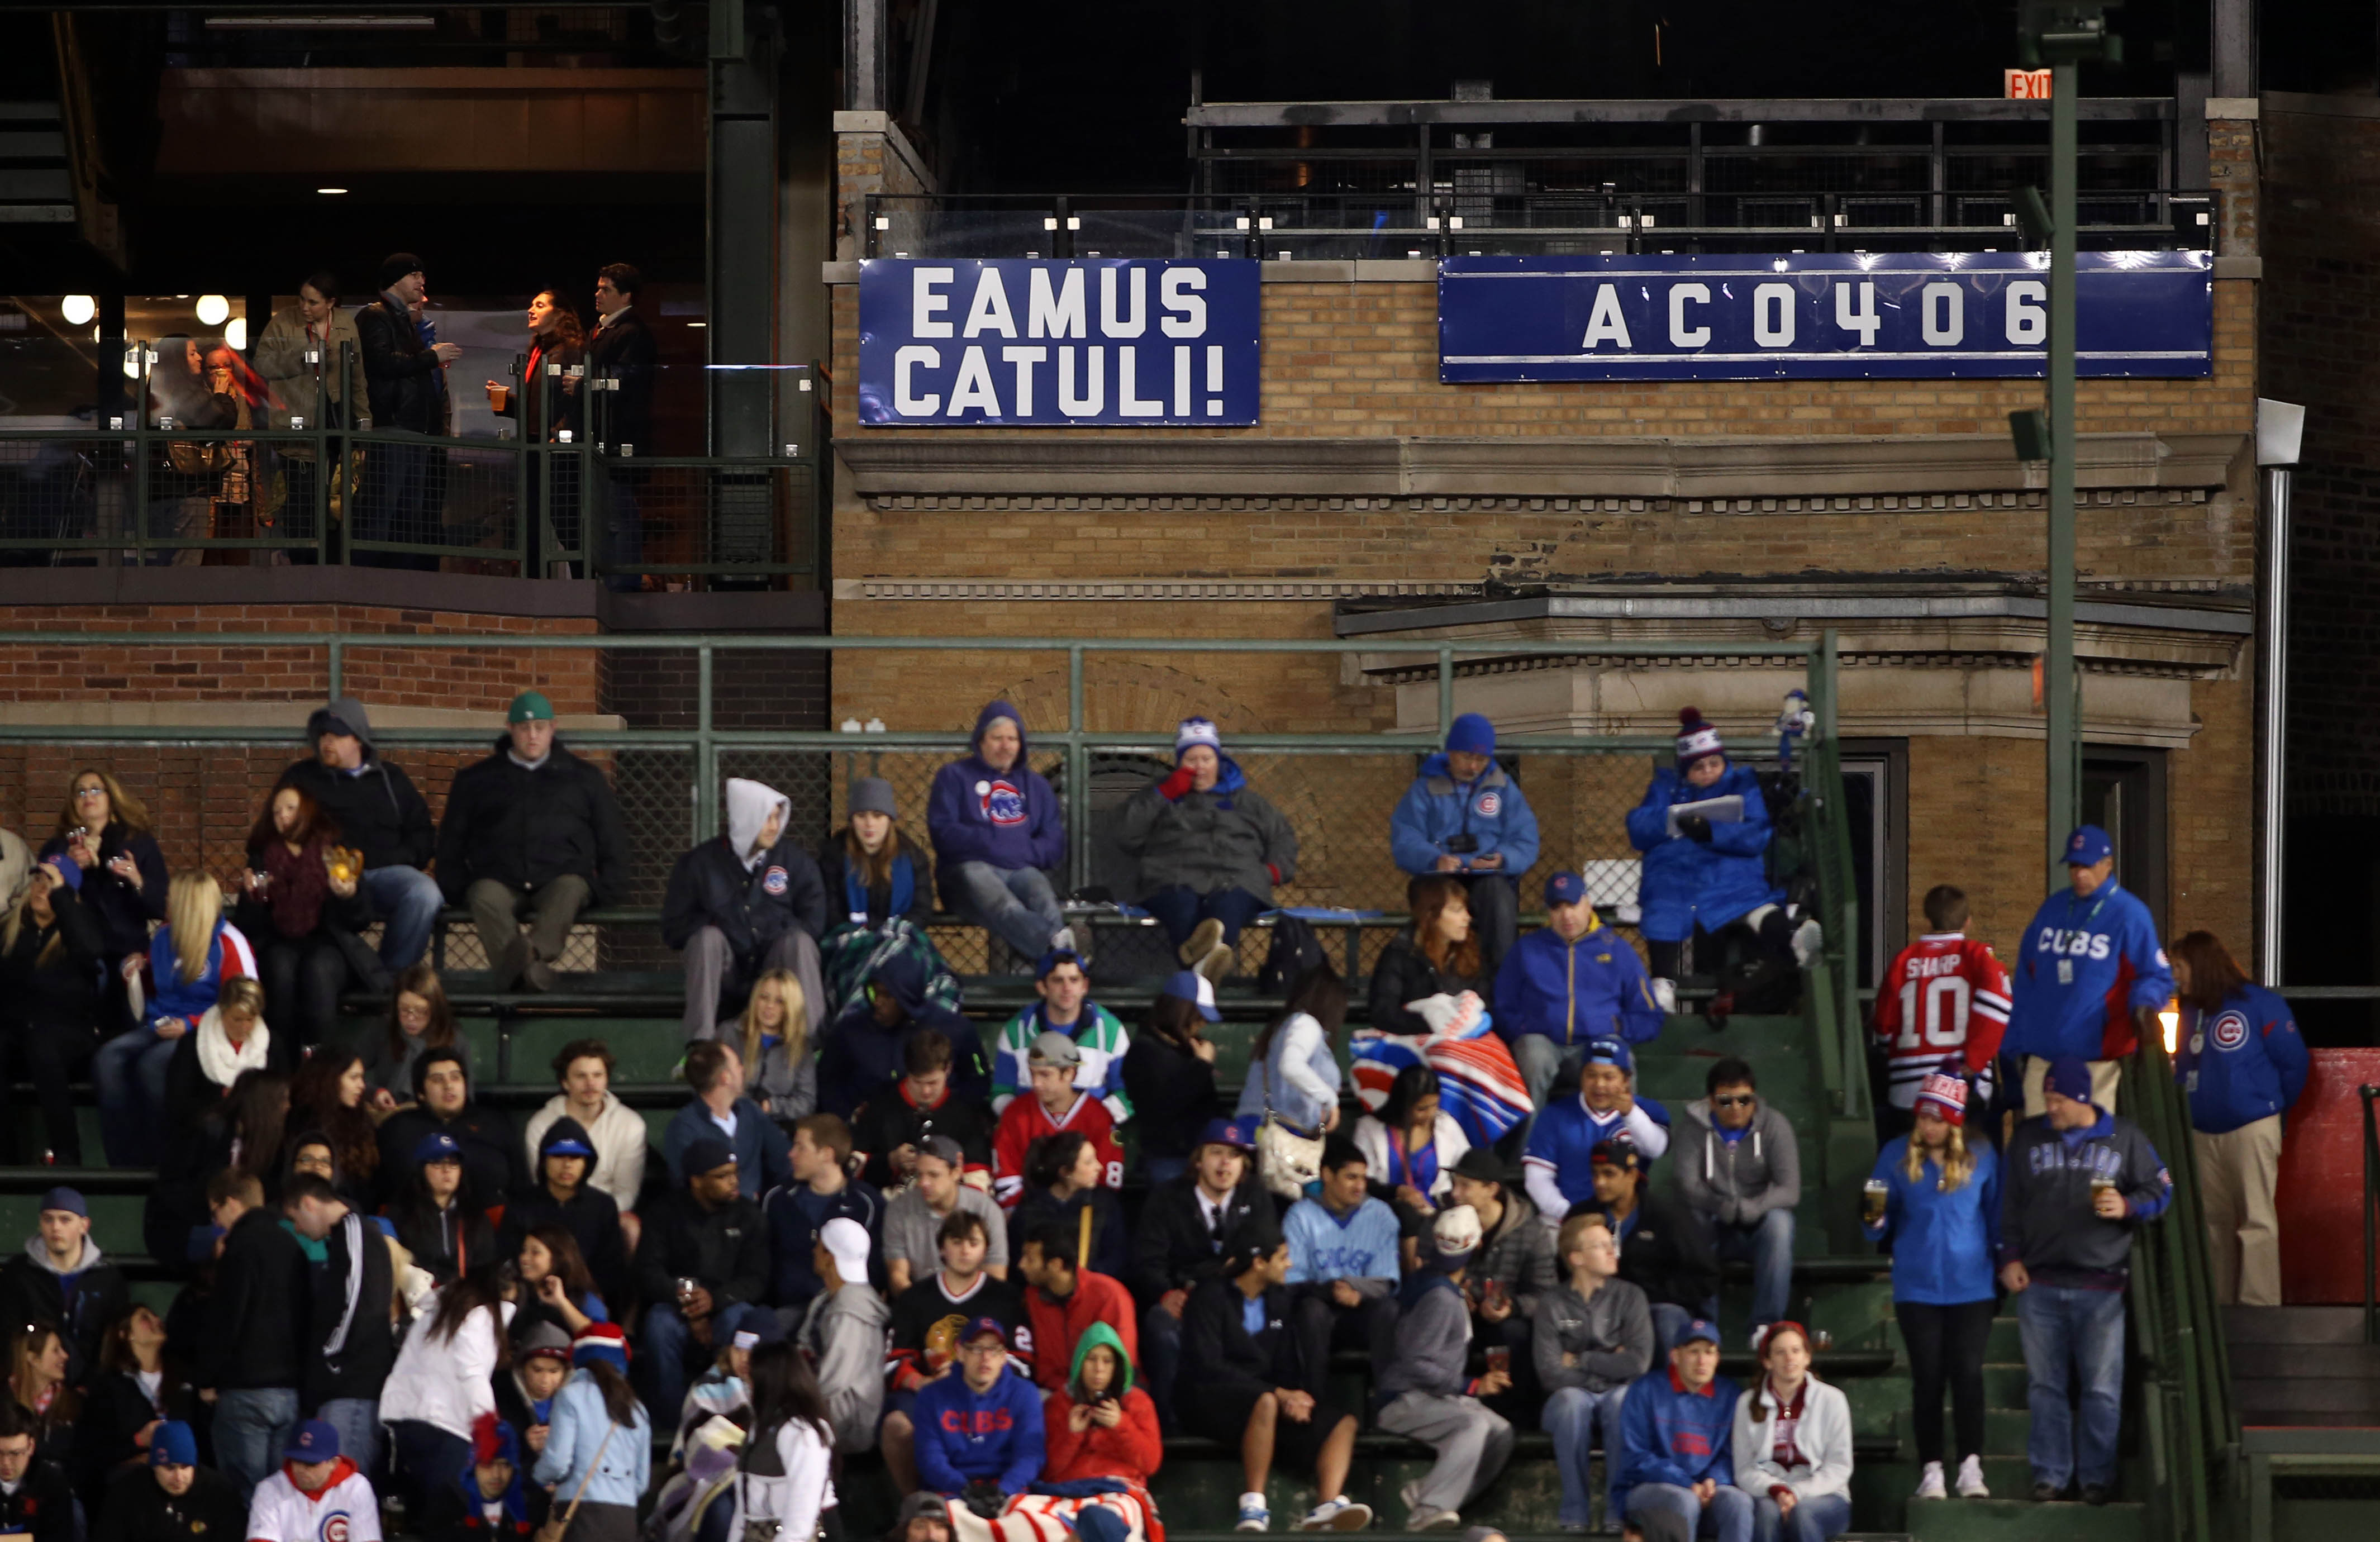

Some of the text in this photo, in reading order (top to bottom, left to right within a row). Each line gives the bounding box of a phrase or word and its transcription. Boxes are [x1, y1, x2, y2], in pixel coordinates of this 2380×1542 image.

[2011, 74, 2052, 99] EXIT
[912, 266, 1207, 339] EAMUS
[894, 345, 1225, 417] CATULI!
[2037, 926, 2111, 960] CUBS
[1906, 953, 1962, 979] SHARP
[1897, 975, 1970, 1049] 10
[941, 1407, 1013, 1434] CUBS
